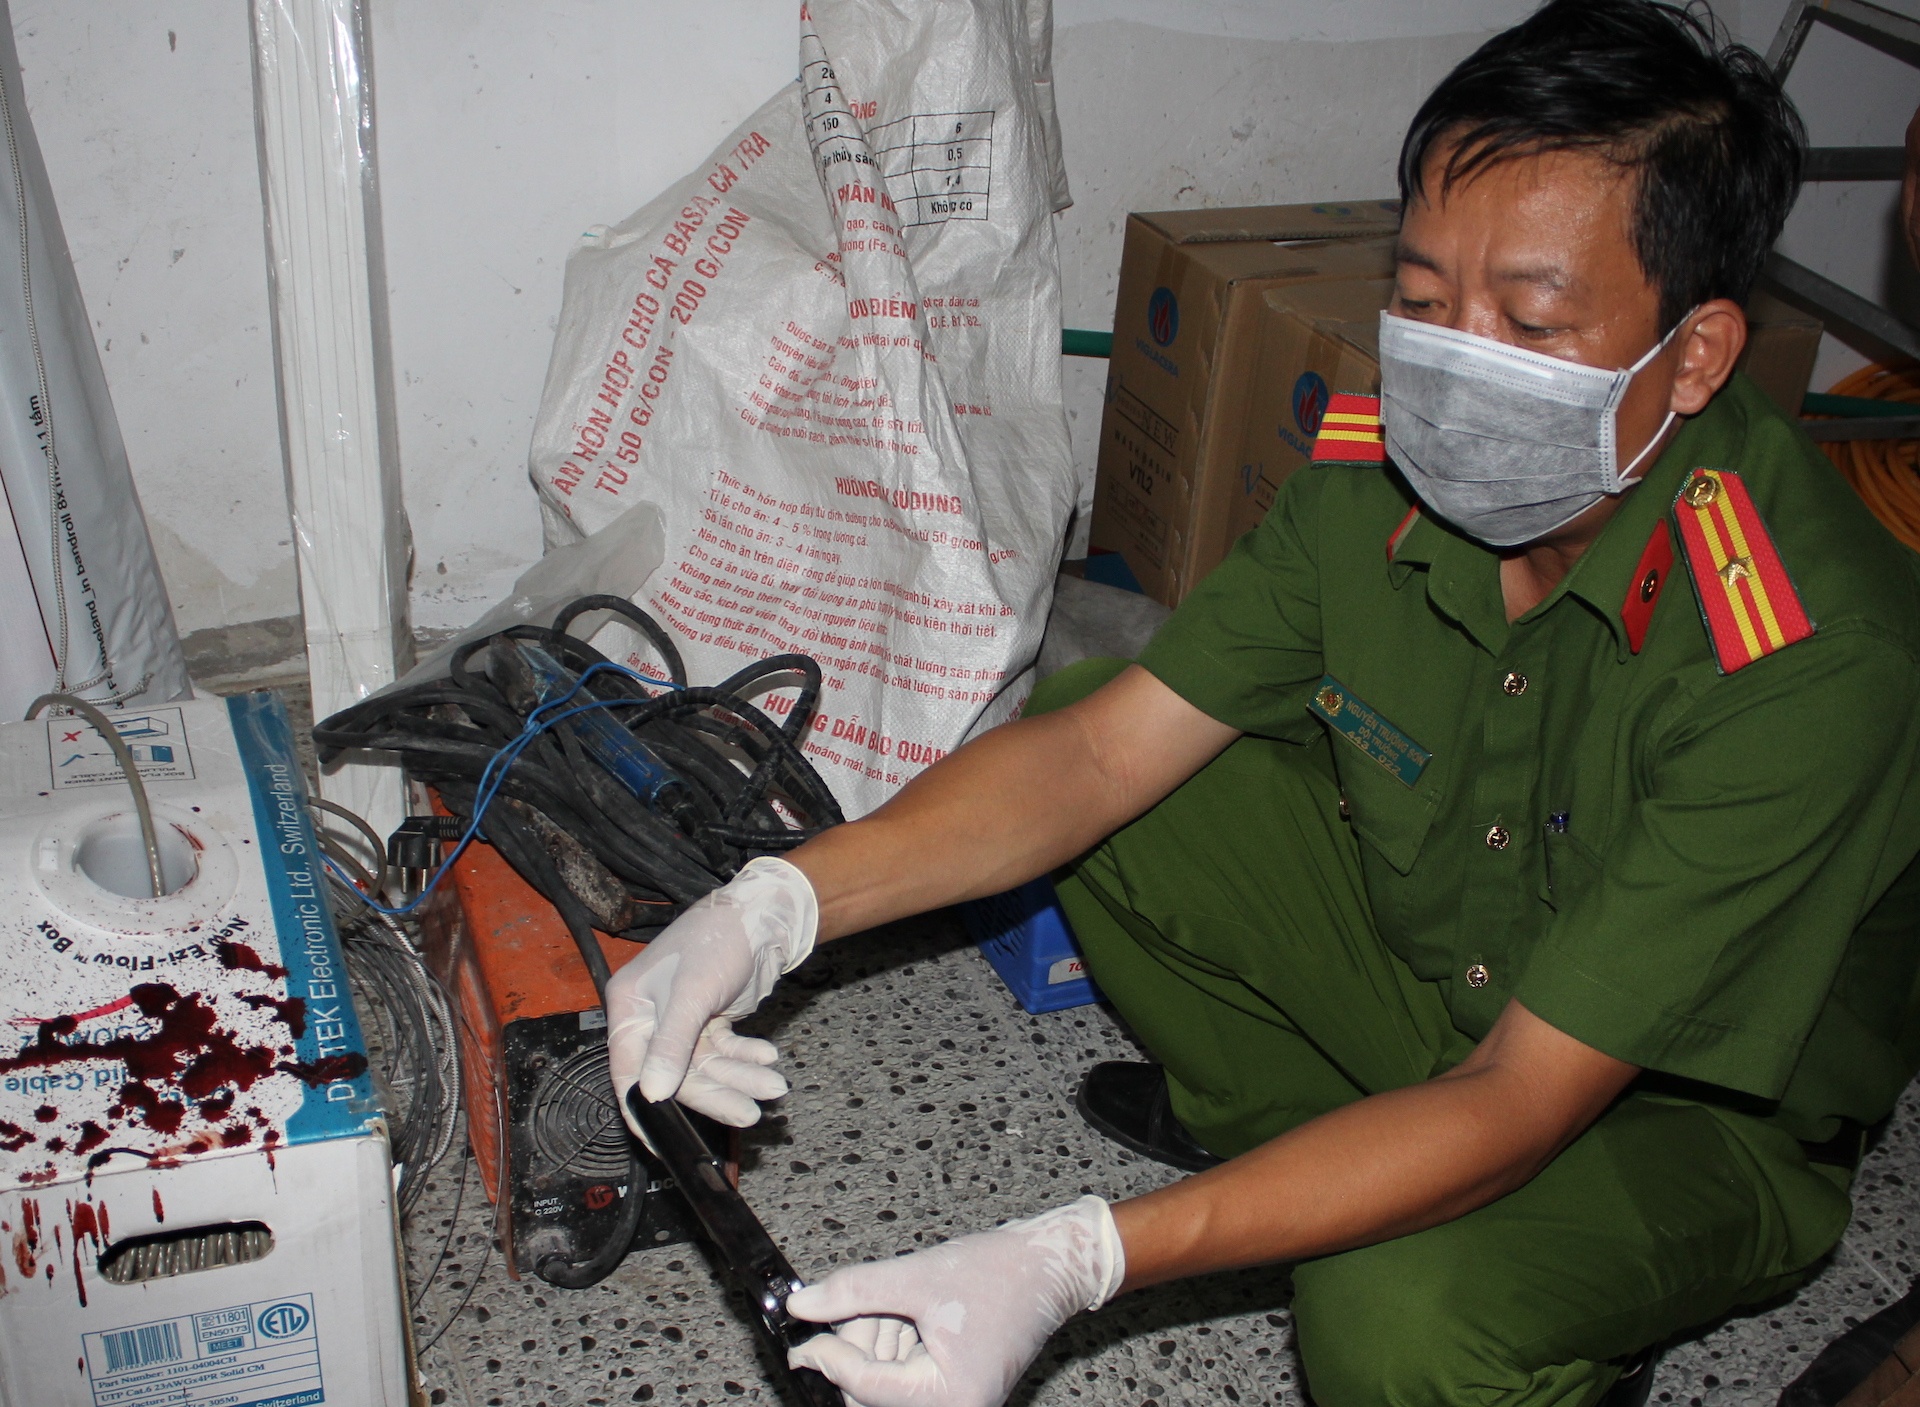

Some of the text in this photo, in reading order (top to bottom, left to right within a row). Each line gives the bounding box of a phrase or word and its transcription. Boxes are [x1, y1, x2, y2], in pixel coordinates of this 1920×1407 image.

[821, 117, 840, 132] 150
[954, 122, 963, 134] 6
[550, 461, 586, 497] ĂN
[572, 407, 614, 463] HỖN
[597, 350, 636, 409] HỢP
[621, 292, 661, 351] CHO
[645, 253, 679, 292] CÁ
[728, 131, 772, 171] TRA
[593, 206, 752, 497] TỪ 50 G/CON 200 G/CON
[716, 469, 741, 490] Thức
[731, 500, 752, 517] cho
[771, 516, 782, 528] 4
[791, 521, 800, 534] 5
[60, 513, 86, 579] bandroll
[734, 522, 754, 540] cho
[775, 536, 785, 548] 3
[794, 543, 804, 555] 4
[688, 545, 709, 562] Cho
[709, 554, 723, 570] cá
[697, 527, 719, 545] Nên
[718, 538, 737, 554] cho
[753, 549, 775, 566] trên
[776, 557, 801, 576] diện
[978, 602, 997, 616] khi
[679, 561, 712, 585] Không
[711, 575, 733, 590] nên
[660, 590, 682, 611] Nên
[722, 616, 746, 633] thức
[759, 629, 788, 652] trong
[670, 576, 694, 597] Màu
[778, 616, 802, 637] thay
[264, 764, 306, 856] Switzerland
[36, 919, 74, 954] Box
[294, 903, 338, 1000] Electronic
[4, 1071, 85, 1095] Cable
[201, 1324, 249, 1339] EN50173
[214, 1309, 247, 1327] 11801
[97, 1378, 120, 1390] Part
[121, 1370, 165, 1386] Number:
[100, 1389, 125, 1402] UTP
[219, 1366, 246, 1381] Solid
[246, 1363, 266, 1375] CM
